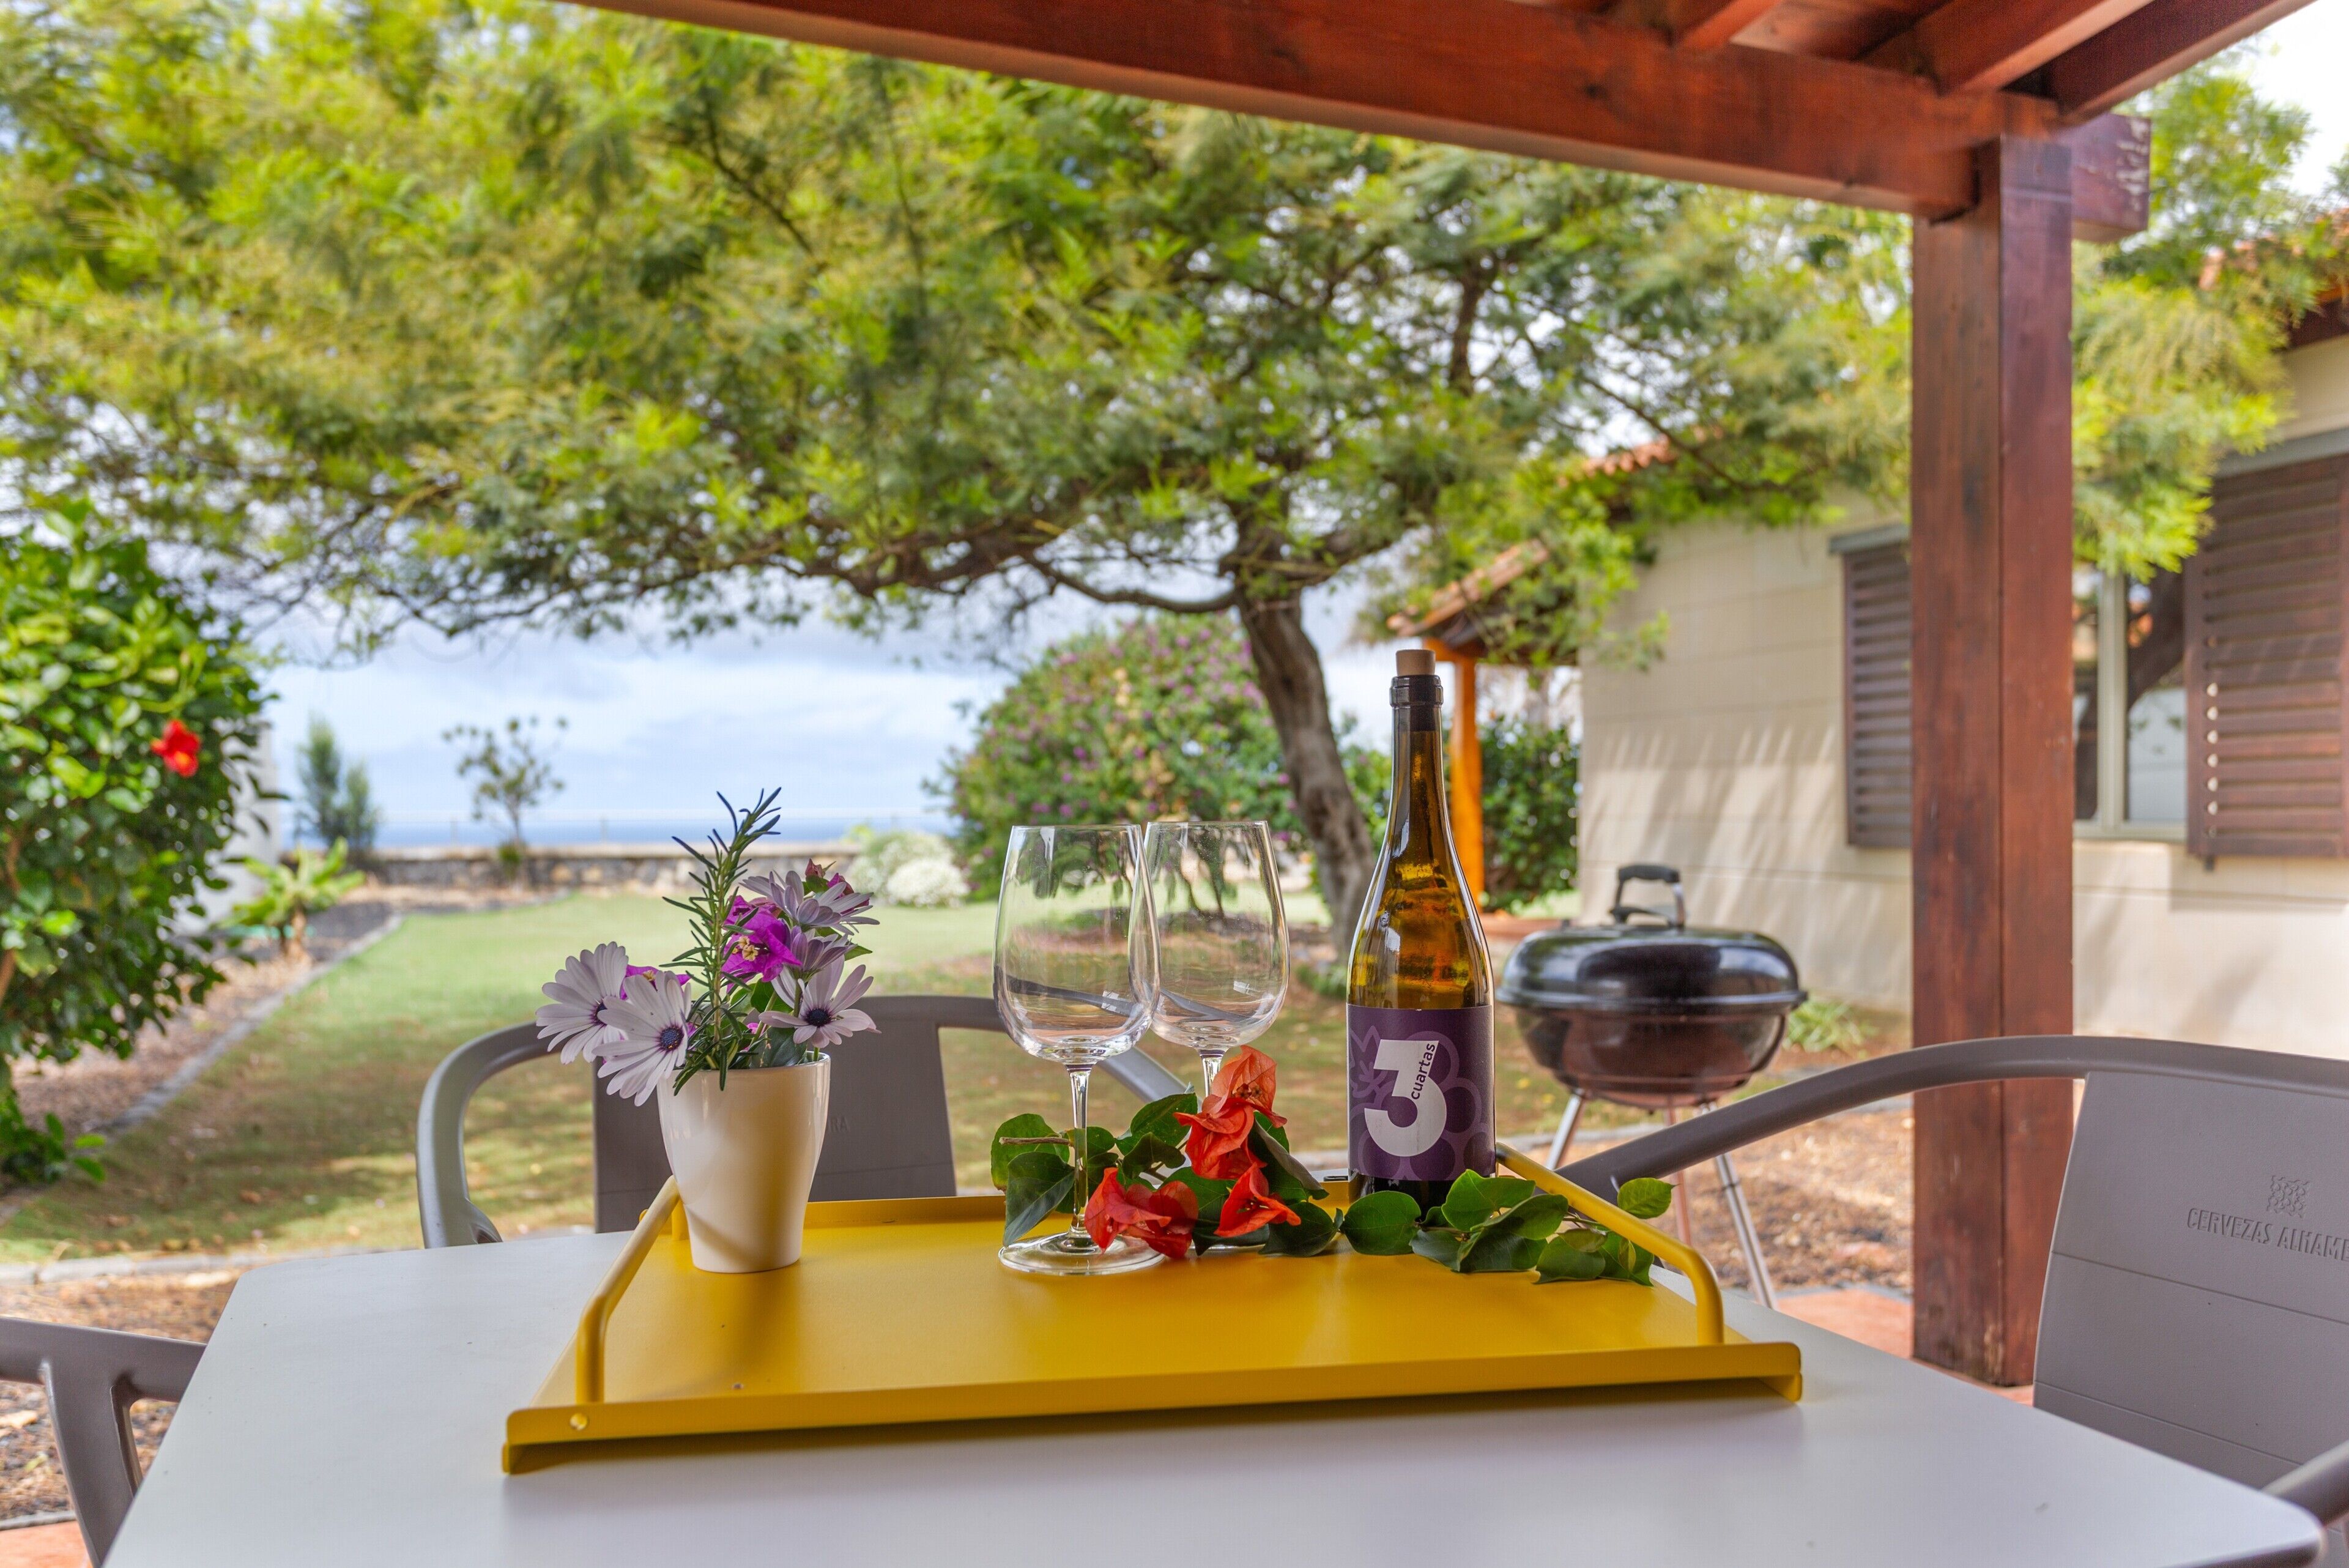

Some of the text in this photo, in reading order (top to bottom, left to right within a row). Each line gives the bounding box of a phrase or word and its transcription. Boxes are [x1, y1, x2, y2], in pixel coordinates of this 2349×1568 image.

[1364, 1039, 1447, 1157] 3 cuartas
[2187, 1208, 2273, 1244] CERVEZAS
